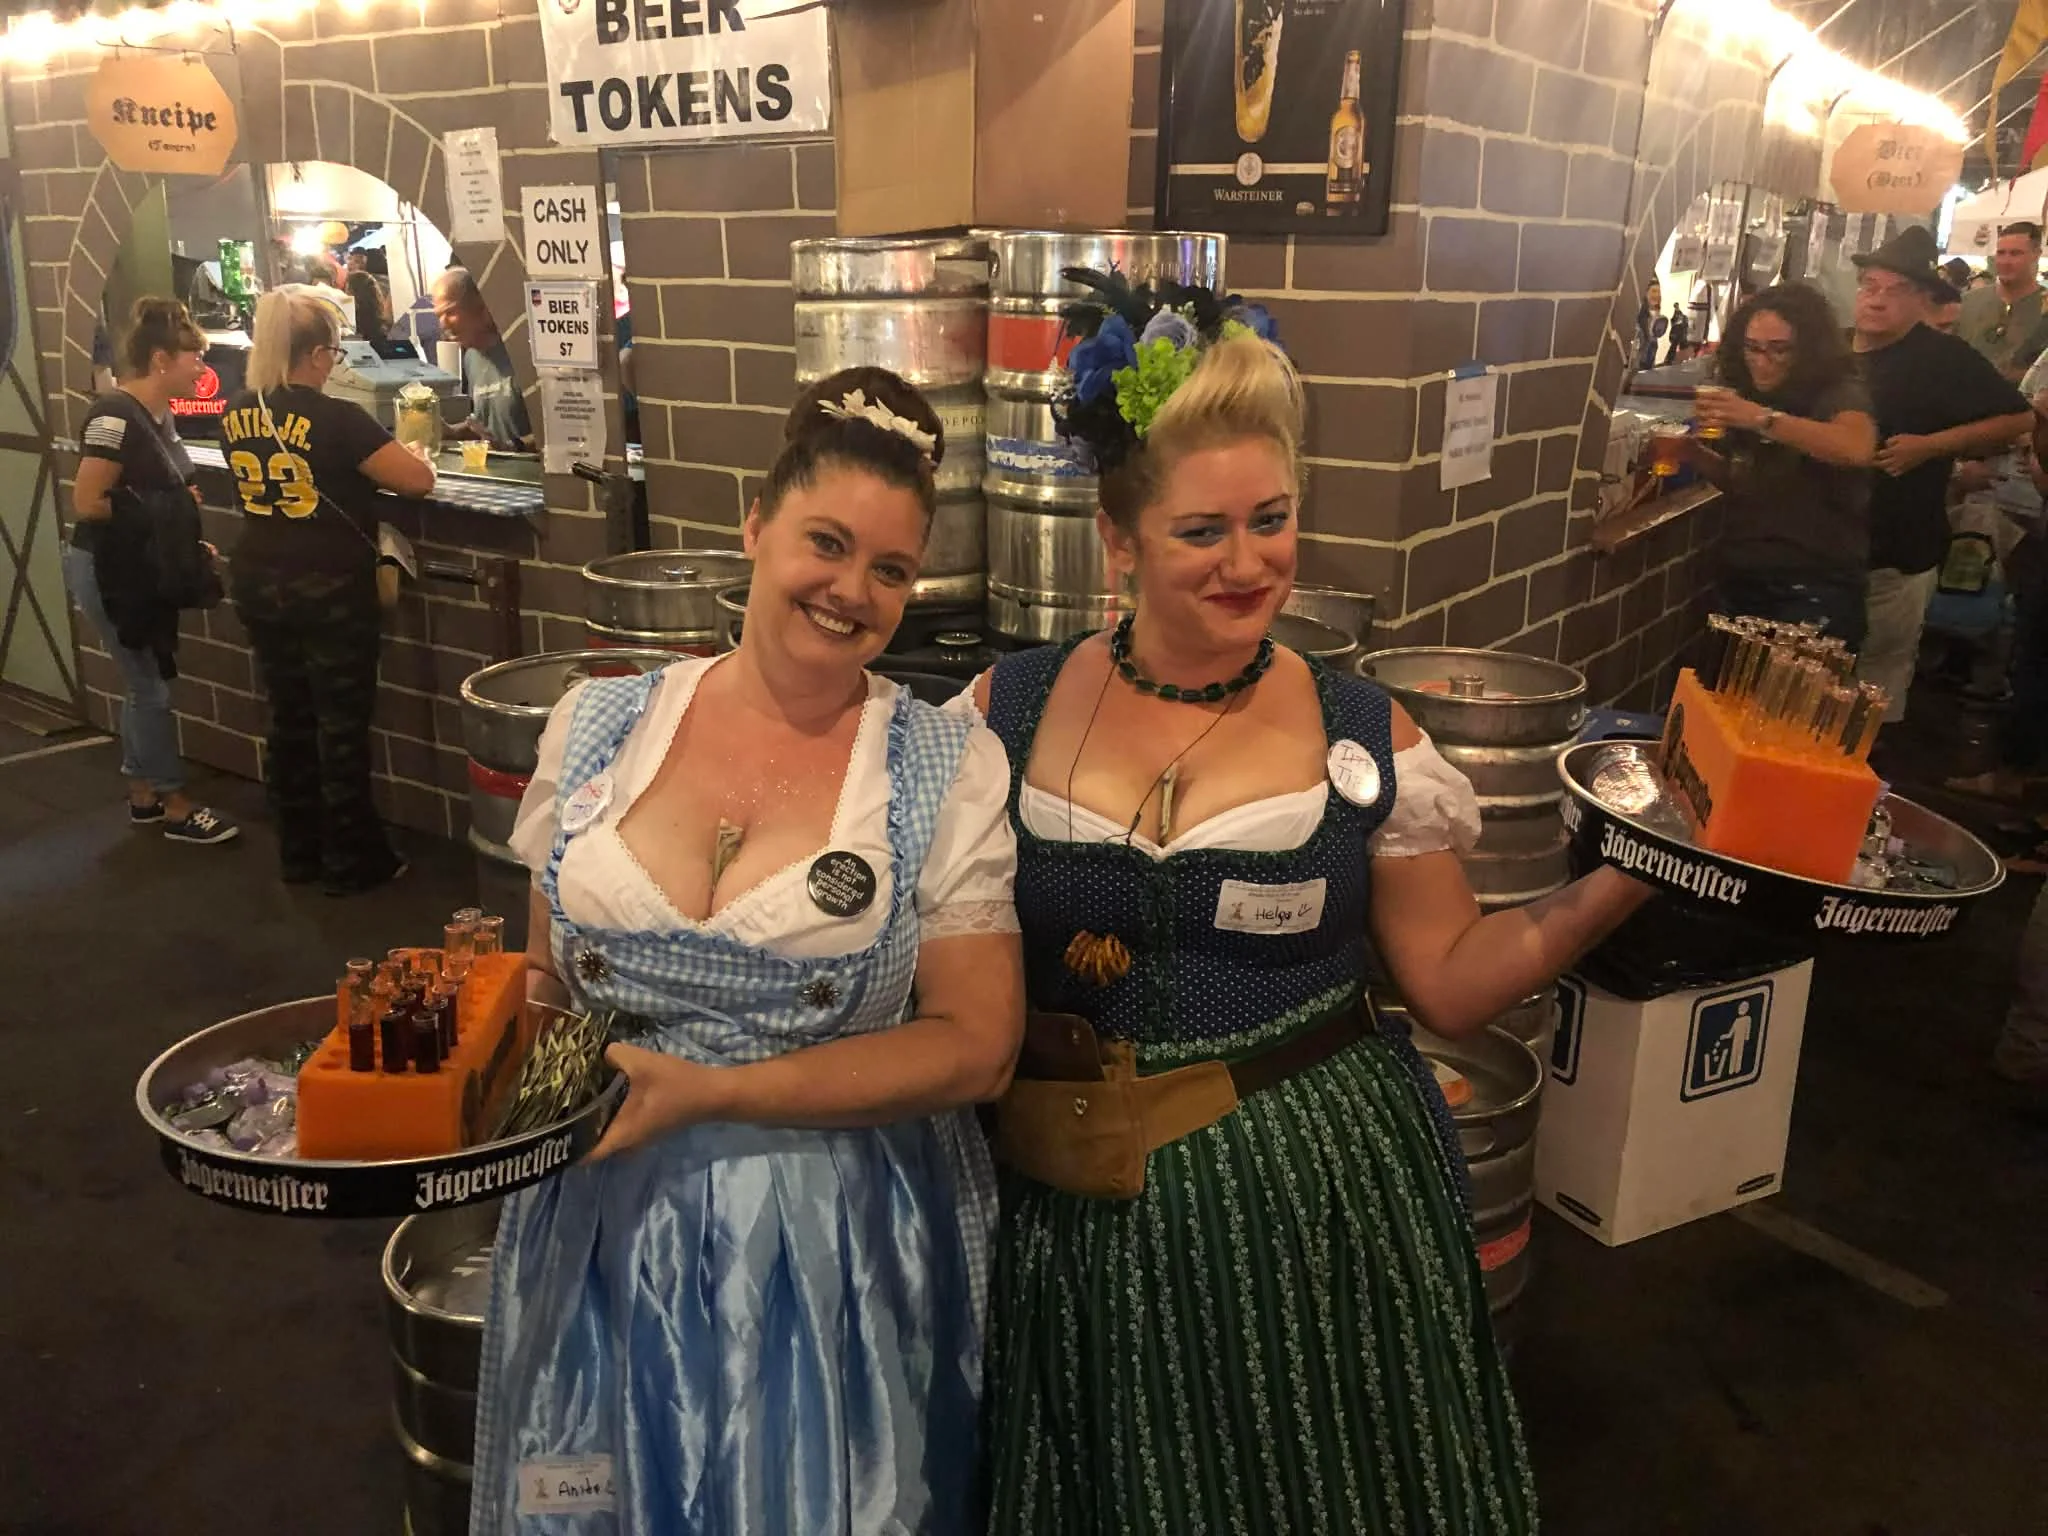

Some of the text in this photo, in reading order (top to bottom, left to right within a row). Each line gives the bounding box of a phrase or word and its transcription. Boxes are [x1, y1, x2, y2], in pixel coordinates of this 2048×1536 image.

[595, 0, 746, 45] BEER
[560, 63, 793, 133] TOKENS
[112, 97, 217, 137] Kneipe
[148, 140, 196, 153] (Tavern)
[1213, 187, 1284, 202] WARSTEINER
[533, 198, 587, 223] CASH
[536, 239, 590, 264] ONLY
[548, 300, 579, 314] BIER
[537, 319, 590, 335] TOKENS
[559, 342, 574, 356] $7
[222, 407, 312, 451] TATIS JR.
[230, 450, 320, 519] 23
[830, 859, 867, 882] erection
[843, 858, 857, 868] An
[1600, 821, 1748, 905] Jägermeister
[815, 869, 865, 899] considered
[815, 878, 856, 903] personal
[841, 873, 857, 885] not
[1814, 895, 1960, 939] Jägermeister
[177, 1146, 329, 1213] Jägermeister
[414, 1131, 573, 1209] Jägermeister
